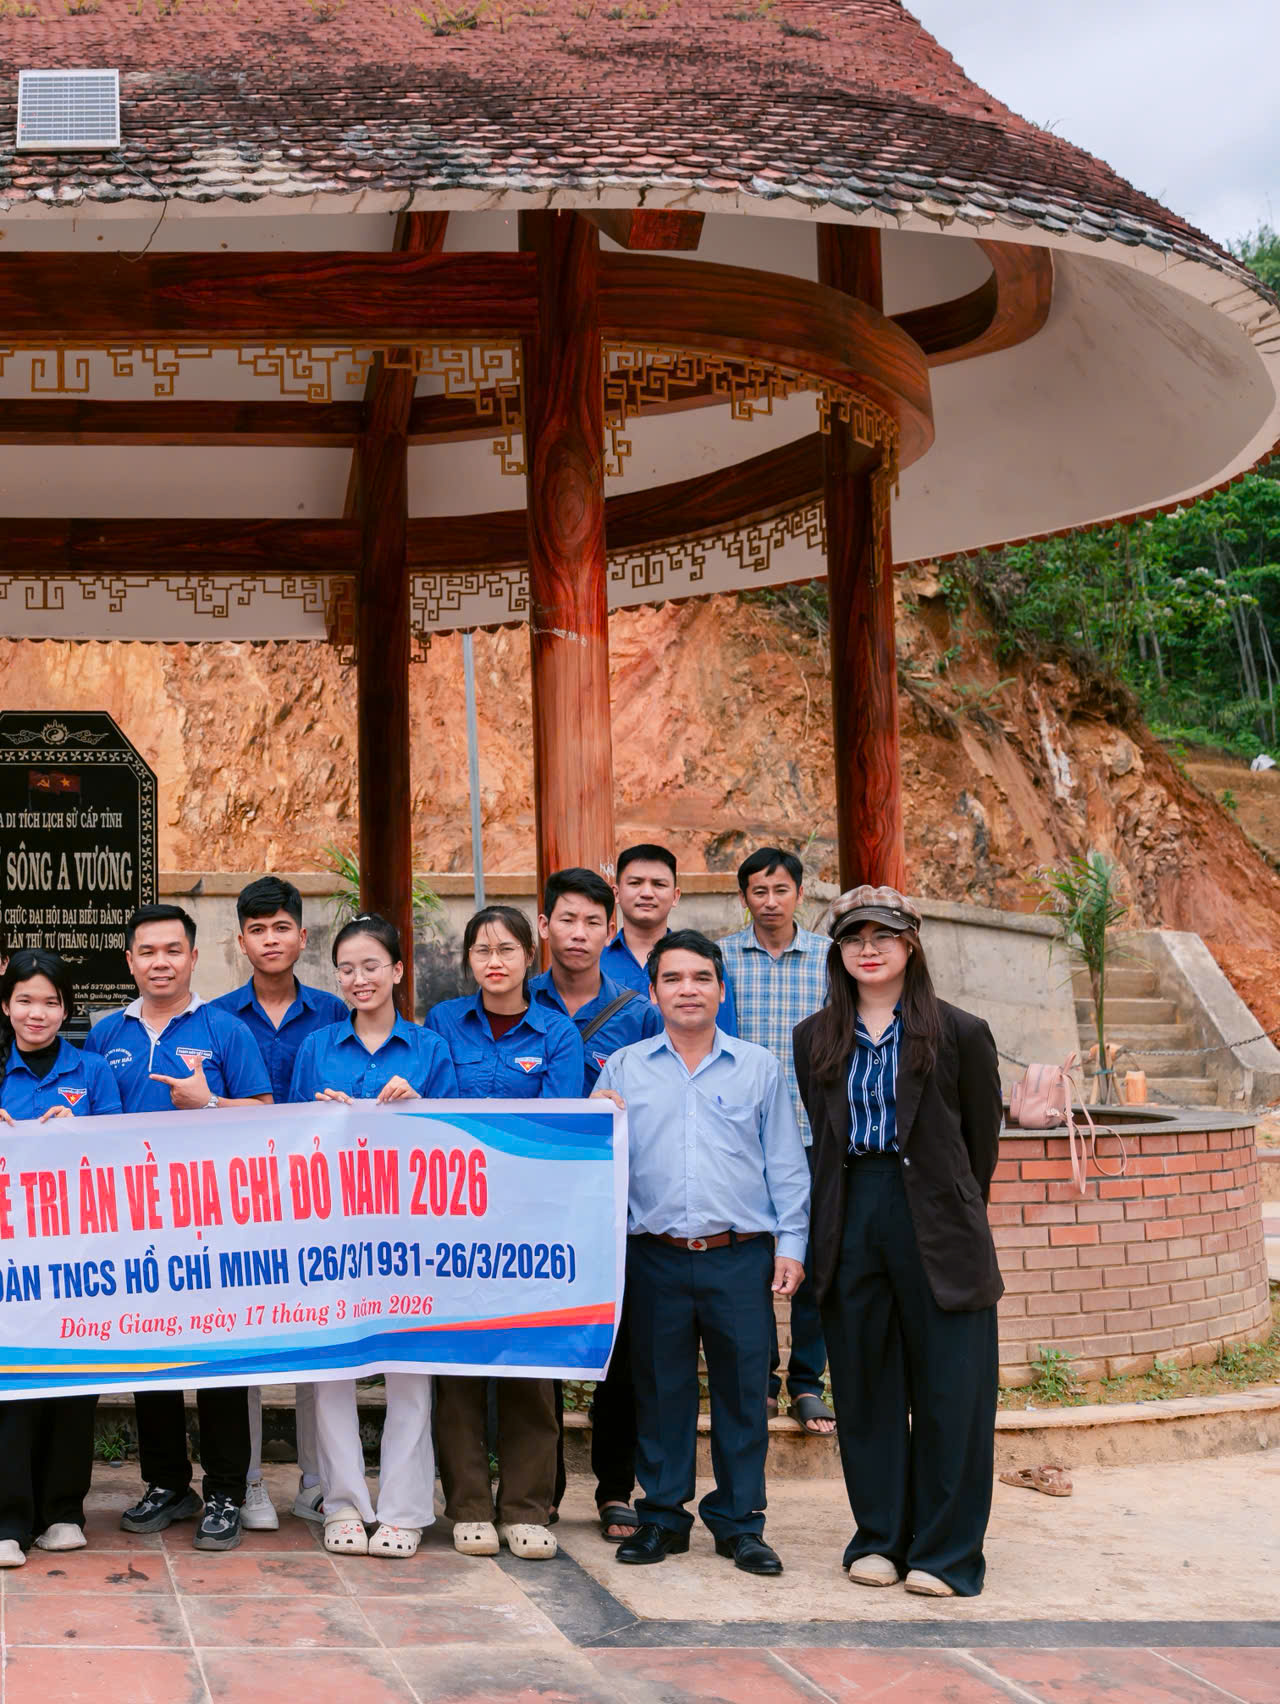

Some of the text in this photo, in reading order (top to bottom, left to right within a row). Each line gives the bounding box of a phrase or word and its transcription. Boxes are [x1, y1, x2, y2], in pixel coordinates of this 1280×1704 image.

[6, 812, 16, 829] DI
[19, 808, 41, 829] TÍCH
[42, 812, 64, 832] LỊCH
[66, 806, 79, 829] SỬ
[80, 805, 98, 829] CẤP
[100, 806, 123, 829] TỈNH
[6, 840, 53, 891] SÔNG
[57, 852, 70, 891] A
[74, 845, 133, 891] VƯƠNG
[4, 904, 27, 924] CHỨC
[29, 909, 44, 928] ĐẠI
[45, 905, 61, 929] HỘI
[62, 909, 77, 928] ĐẠI
[79, 900, 98, 925] BIỂU
[100, 903, 123, 925] ĐẢNG
[7, 925, 126, 951] LẦN THỨ TƯ (THÁNG 01/1960)
[20, 1170, 71, 1238] TRI
[79, 1156, 119, 1234] ÂN
[124, 1141, 163, 1231] VỀ
[169, 1160, 223, 1240] ĐỊA
[229, 1139, 282, 1225] CHỈ
[288, 1136, 332, 1220] ĐỎ
[338, 1137, 400, 1217] NĂM
[409, 1148, 488, 1217] 2026
[48, 1259, 117, 1300] TNCS
[124, 1244, 160, 1294] HỒ
[168, 1246, 212, 1292] CHÍ
[219, 1248, 289, 1288] MINH
[298, 1241, 576, 1287] (26/3/1931-26/3/2026)
[59, 1295, 433, 1341] Đông Giang, ngày 17 tháng 3 năm 2026
